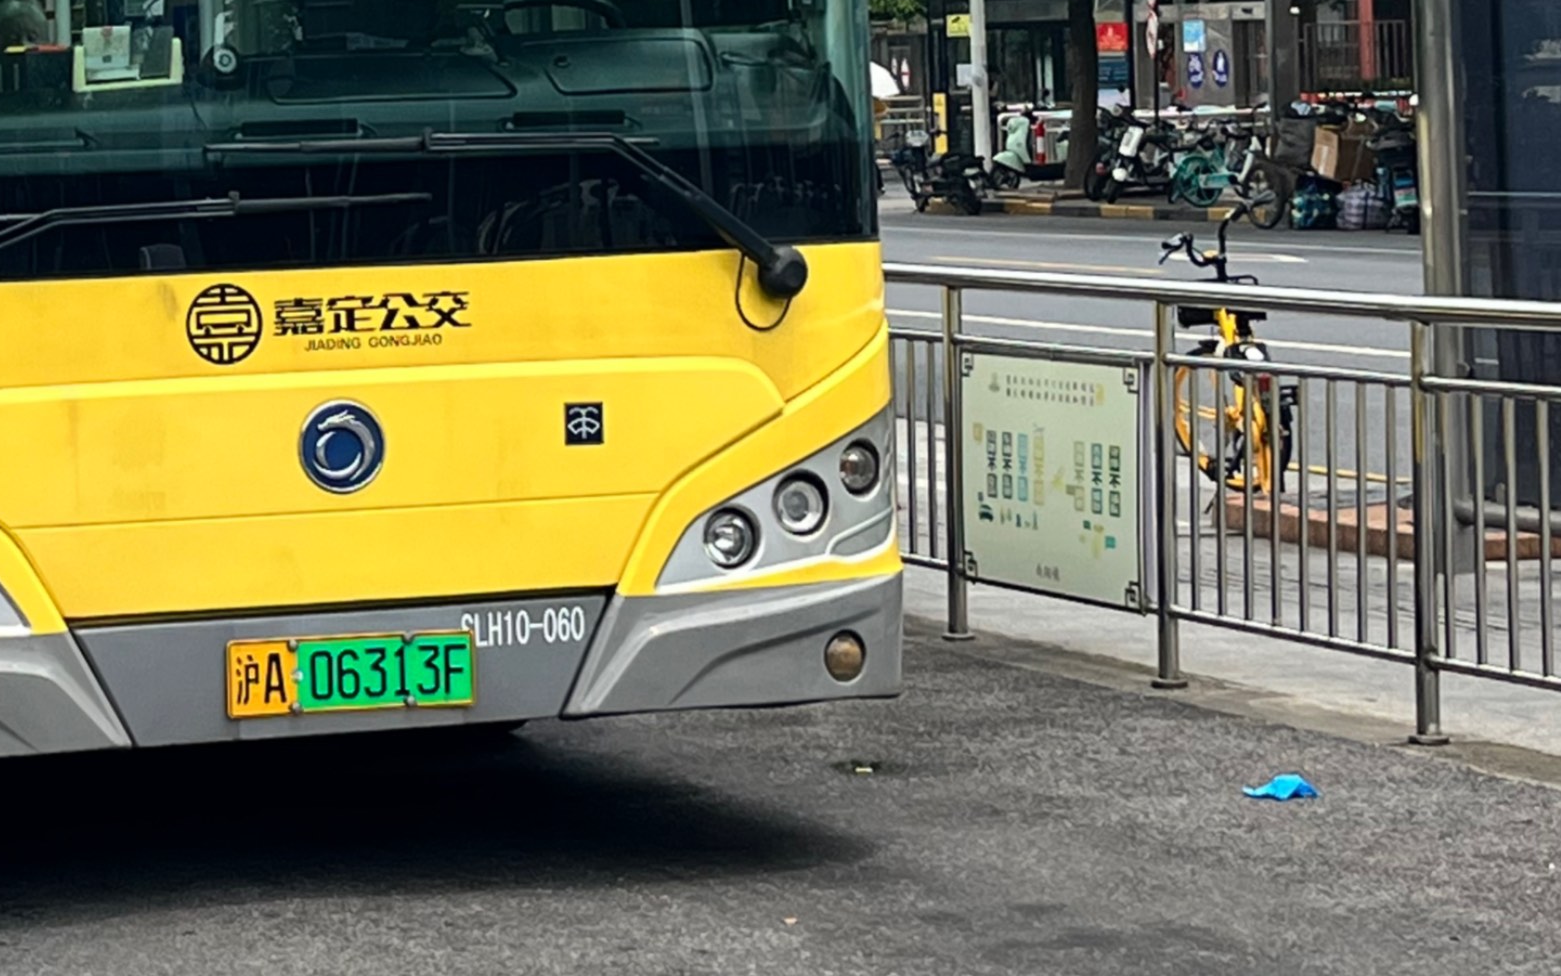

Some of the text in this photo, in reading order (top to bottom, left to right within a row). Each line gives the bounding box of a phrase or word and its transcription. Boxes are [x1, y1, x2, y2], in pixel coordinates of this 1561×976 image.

[272, 290, 471, 336] 嘉定公交
[304, 333, 443, 352] JIADING GONGJIAO
